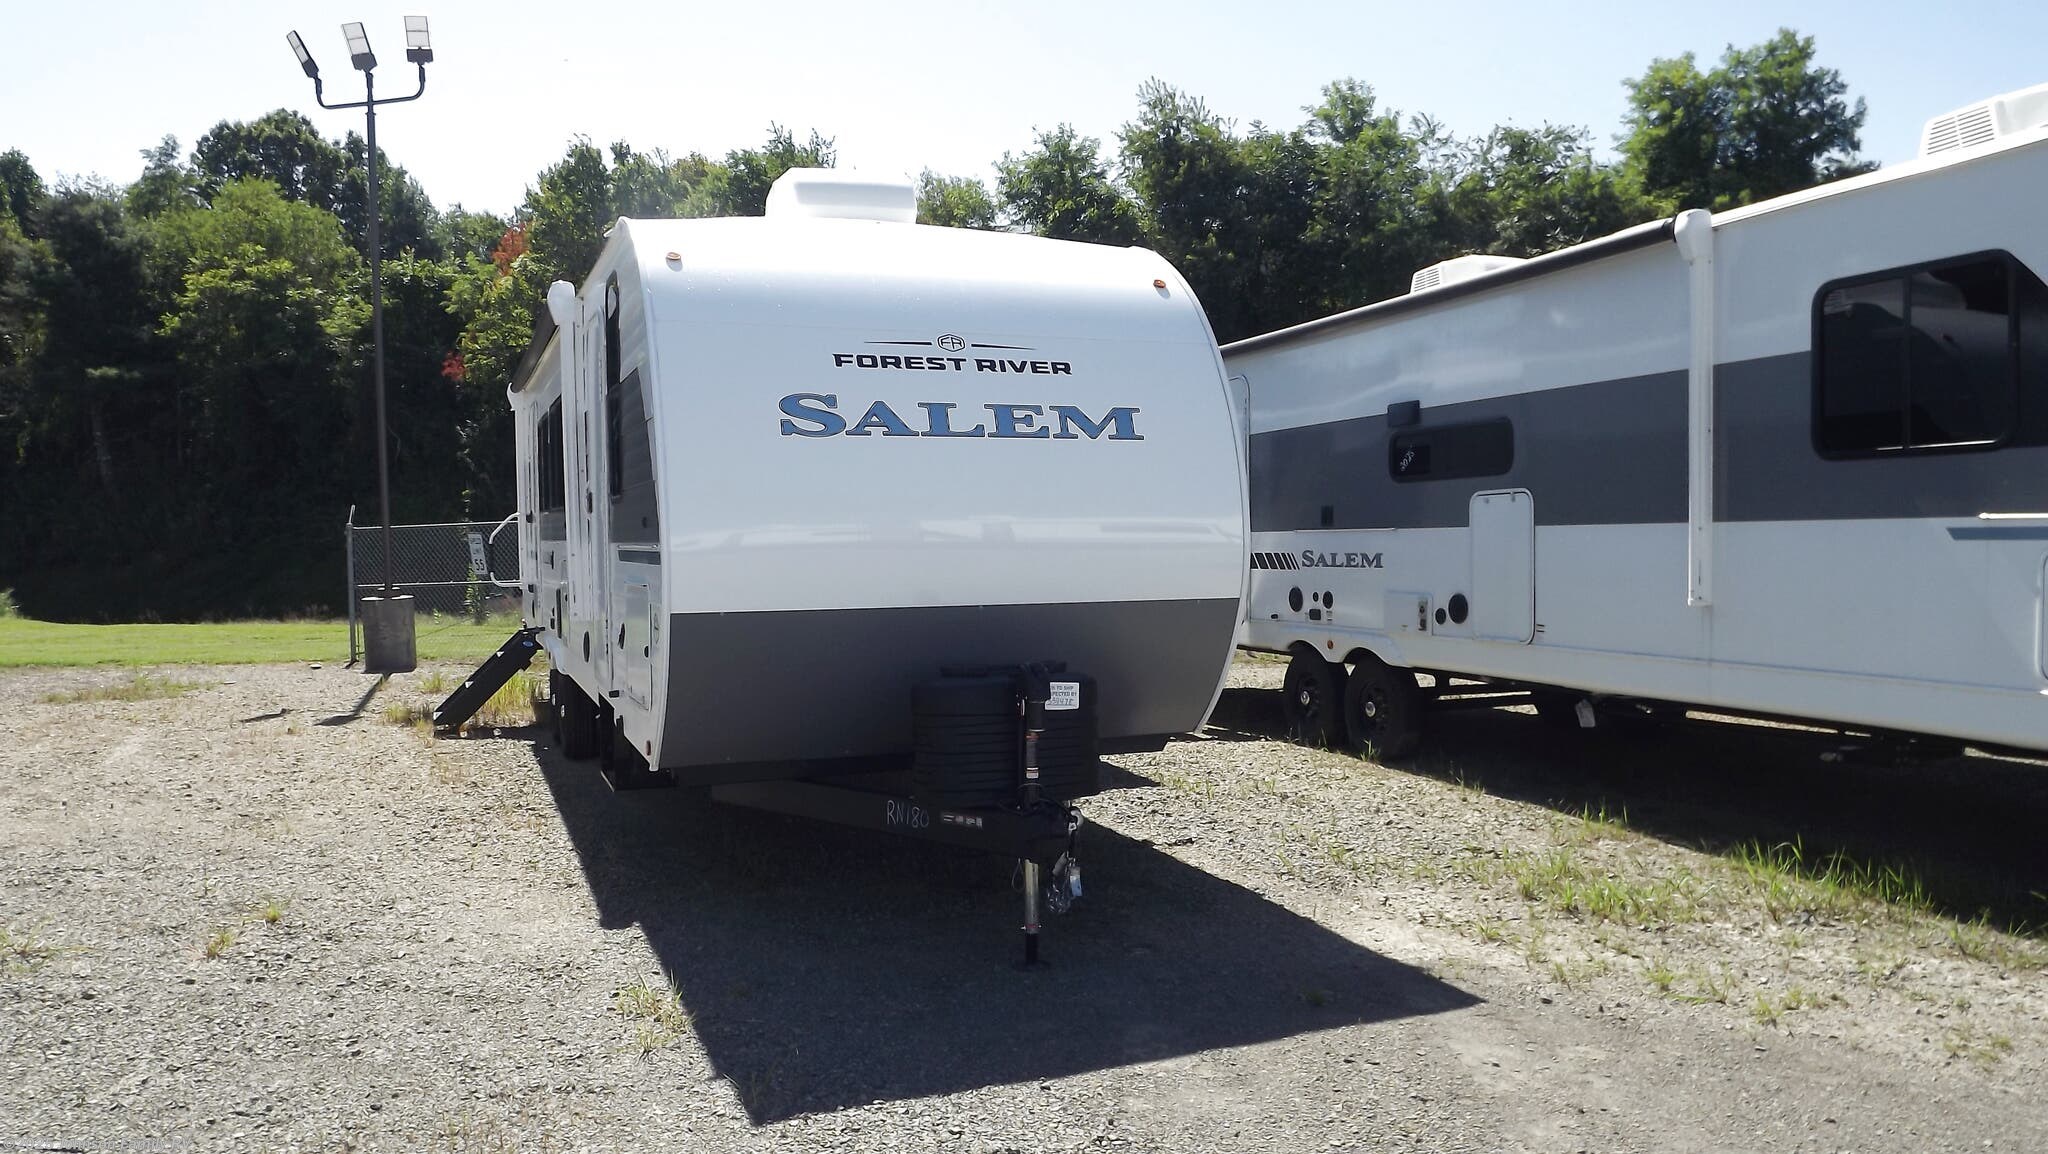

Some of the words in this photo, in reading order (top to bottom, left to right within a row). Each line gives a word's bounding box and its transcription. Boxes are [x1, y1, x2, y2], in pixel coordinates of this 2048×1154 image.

[832, 353, 967, 372] FOREST
[974, 358, 1073, 375] RIVER
[778, 392, 1145, 441] SALEM
[1301, 550, 1384, 568] SALEM
